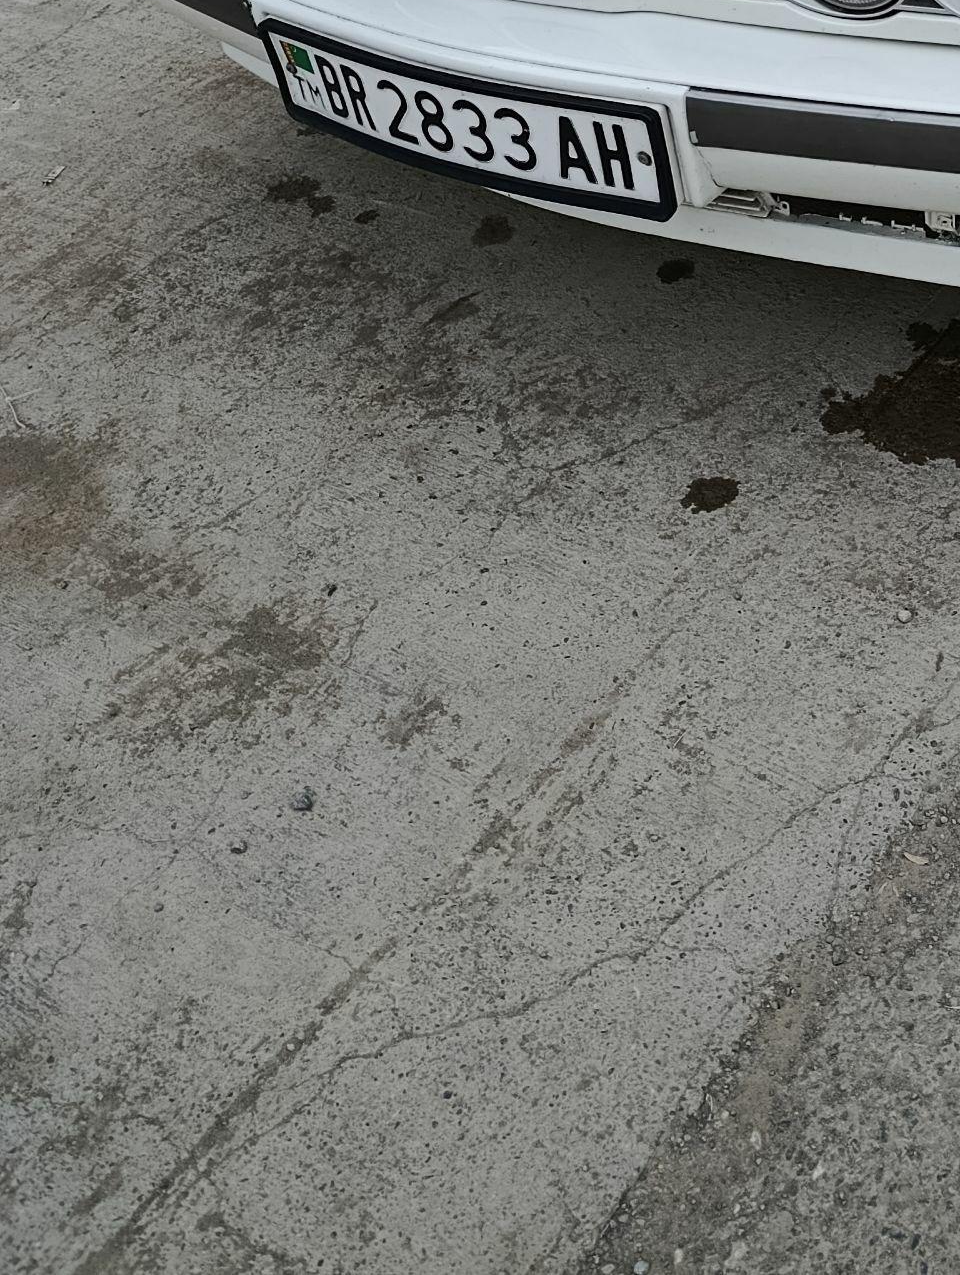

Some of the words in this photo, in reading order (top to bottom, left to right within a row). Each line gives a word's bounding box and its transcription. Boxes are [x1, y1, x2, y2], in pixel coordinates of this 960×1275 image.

[293, 74, 327, 111] TM
[314, 53, 377, 132] BR
[376, 79, 538, 171] 2833
[558, 115, 636, 191] AH
